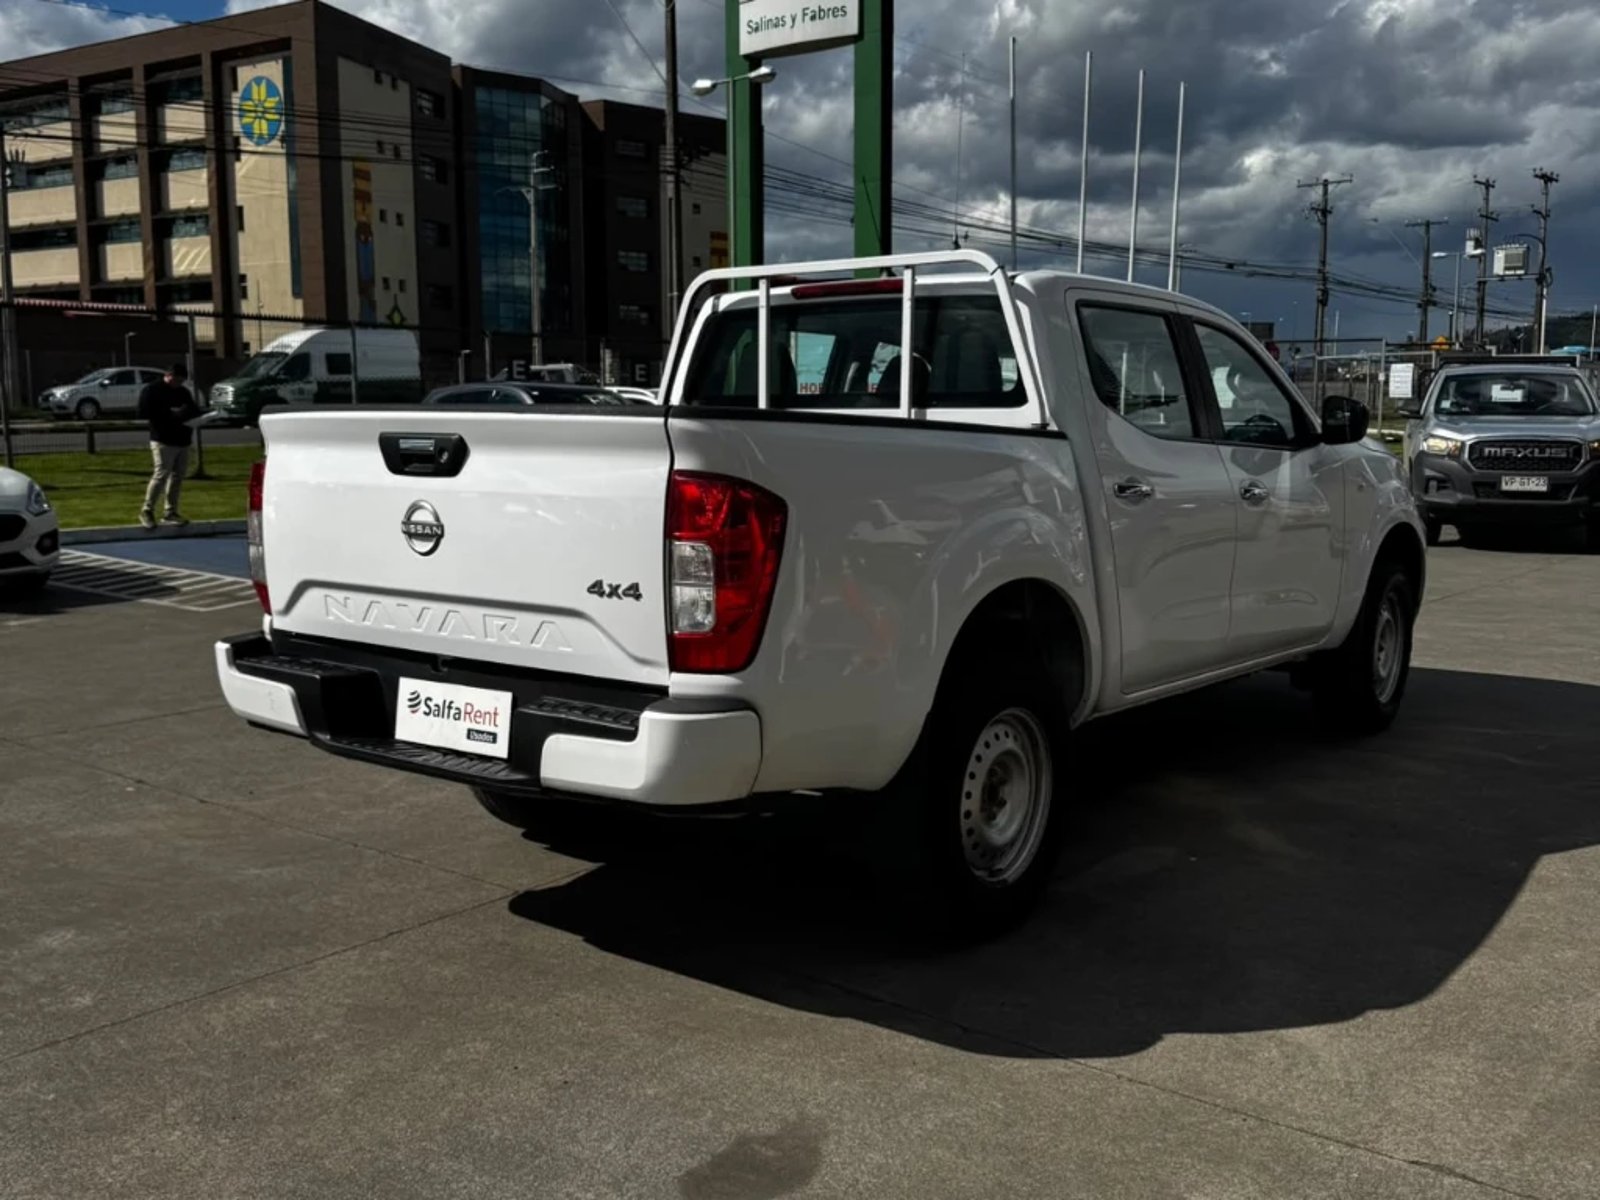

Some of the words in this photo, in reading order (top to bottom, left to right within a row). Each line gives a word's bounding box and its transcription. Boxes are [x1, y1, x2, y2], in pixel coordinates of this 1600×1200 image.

[746, 15, 787, 35] Salinas
[790, 13, 798, 29] y
[802, 5, 847, 24] Fabres
[1483, 447, 1568, 458] MAXUS
[587, 579, 642, 601] 4x4
[324, 595, 573, 652] NAVARA
